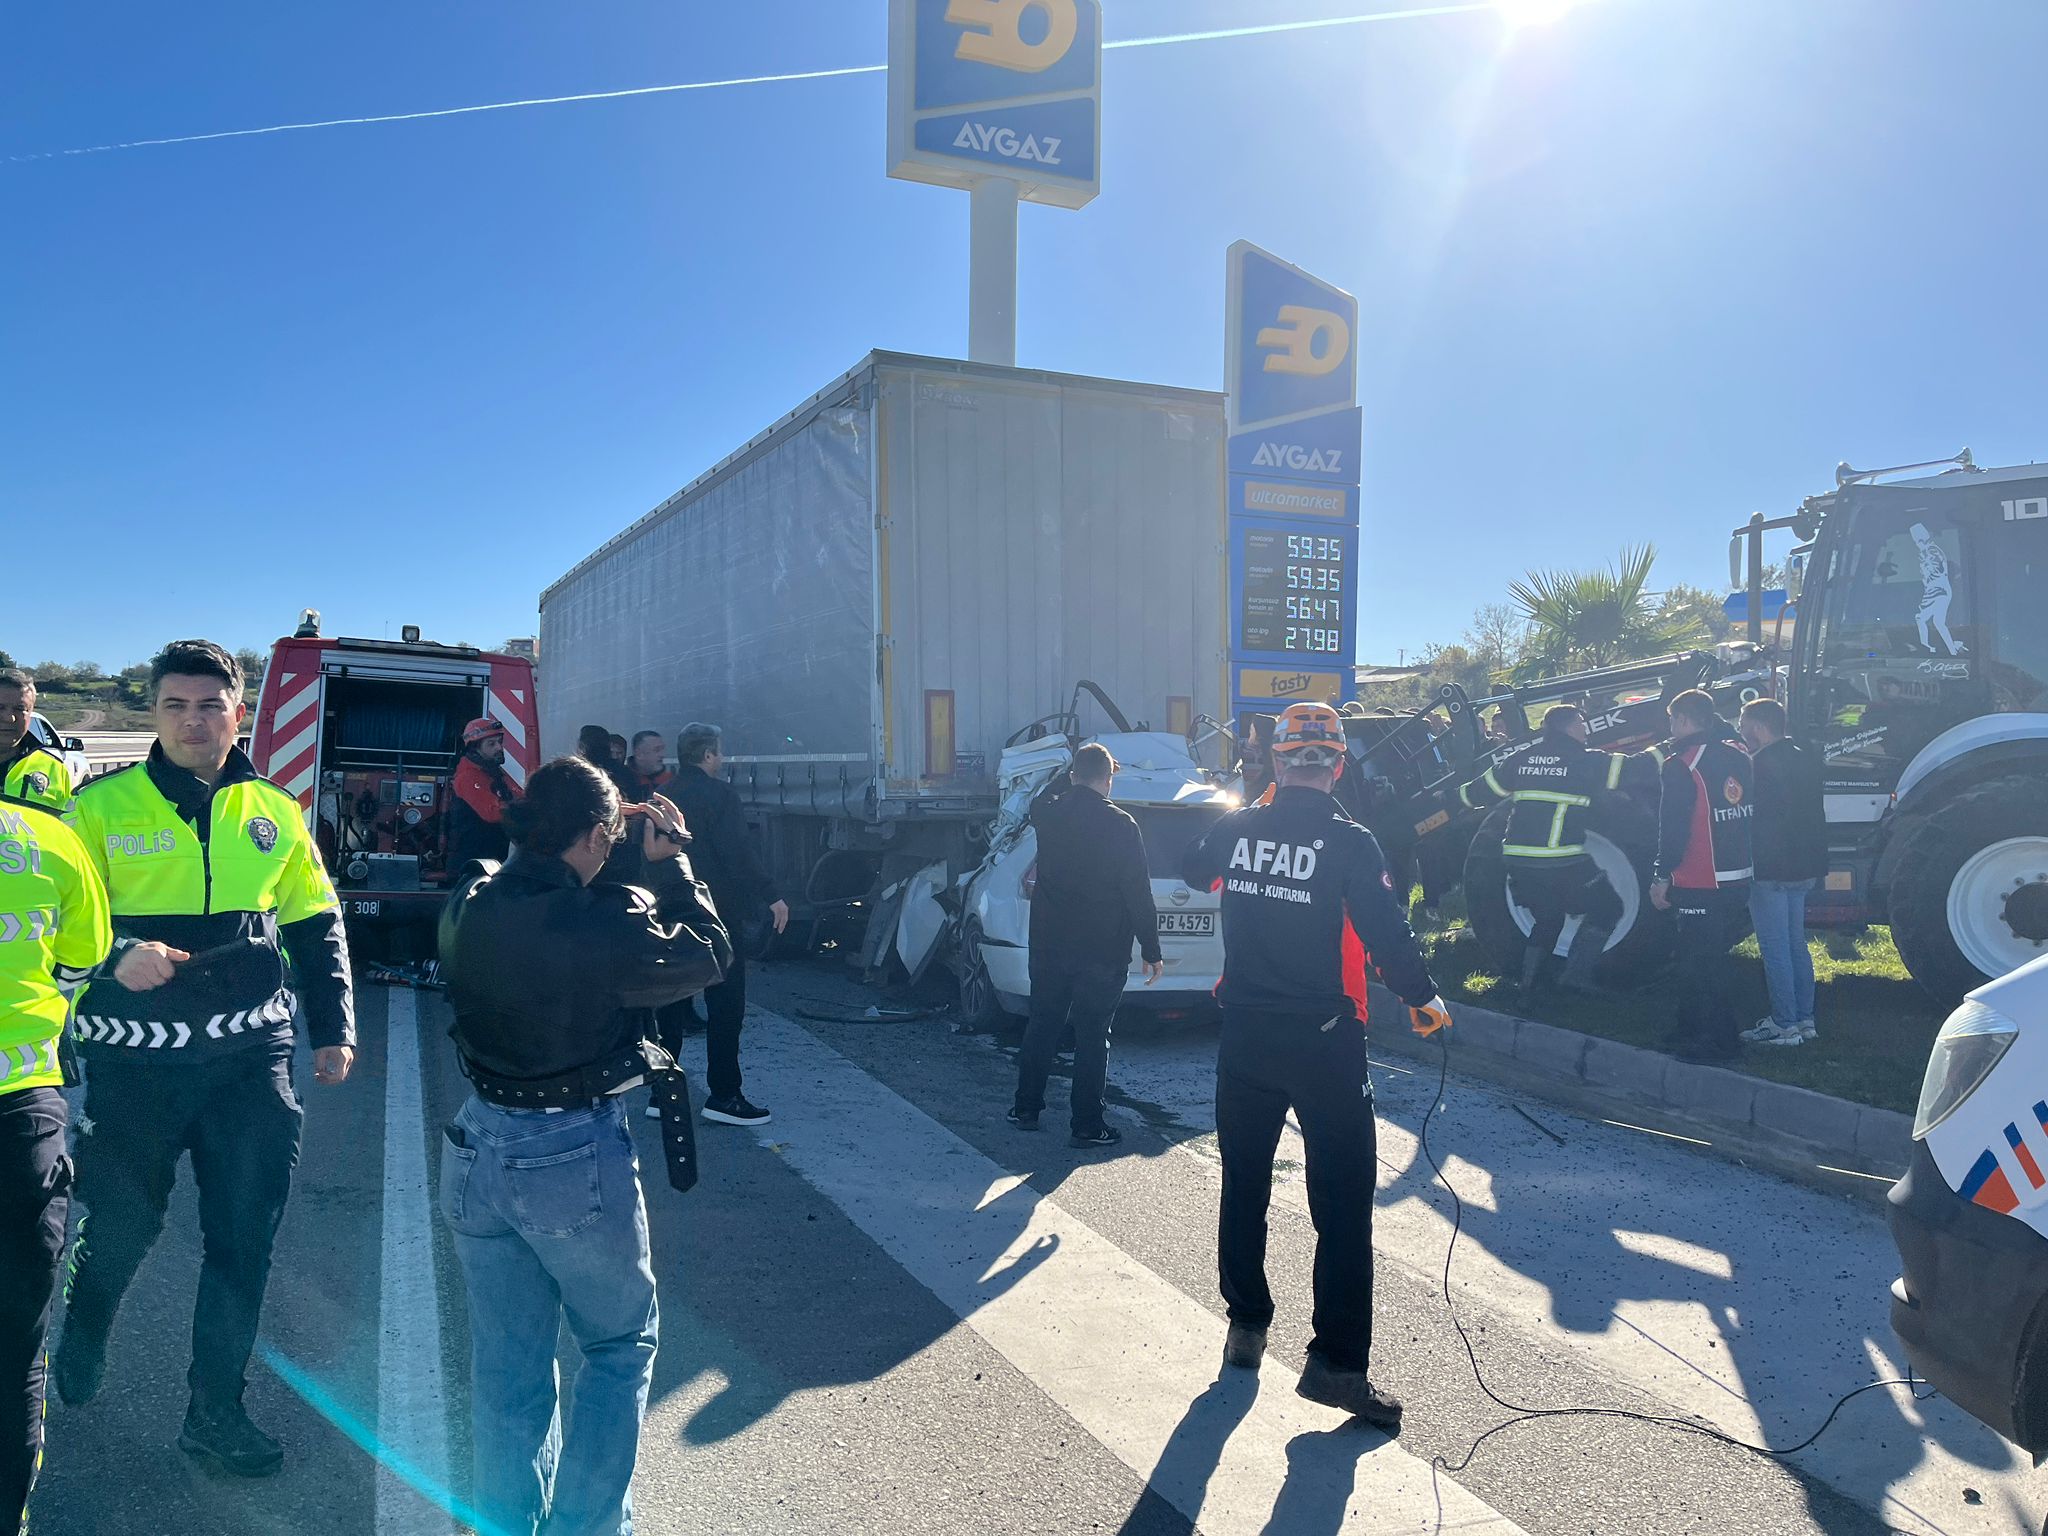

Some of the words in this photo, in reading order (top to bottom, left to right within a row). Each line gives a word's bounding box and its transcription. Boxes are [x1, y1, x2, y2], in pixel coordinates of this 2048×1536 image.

[952, 121, 1062, 165] AYGAZ
[1251, 442, 1342, 473] AYGAZ
[1251, 490, 1337, 510] ultramarket
[1249, 535, 1274, 543] motorin
[1287, 535, 1341, 561] 59.35
[1248, 566, 1274, 574] motorin
[1286, 565, 1340, 592] 59.35
[1285, 596, 1340, 621] 56.47
[1285, 626, 1339, 652] 27.98
[1270, 673, 1312, 697] fasty
[1518, 765, 1567, 777] İTFAİYESİ
[1528, 755, 1560, 765] SİNOP
[1229, 837, 1317, 881] AFAD
[1227, 878, 1258, 895] ARAMA
[1265, 884, 1311, 904] KURTARMA
[354, 901, 377, 915] 308
[1158, 914, 1175, 930] PG
[1178, 914, 1211, 930] 4579
